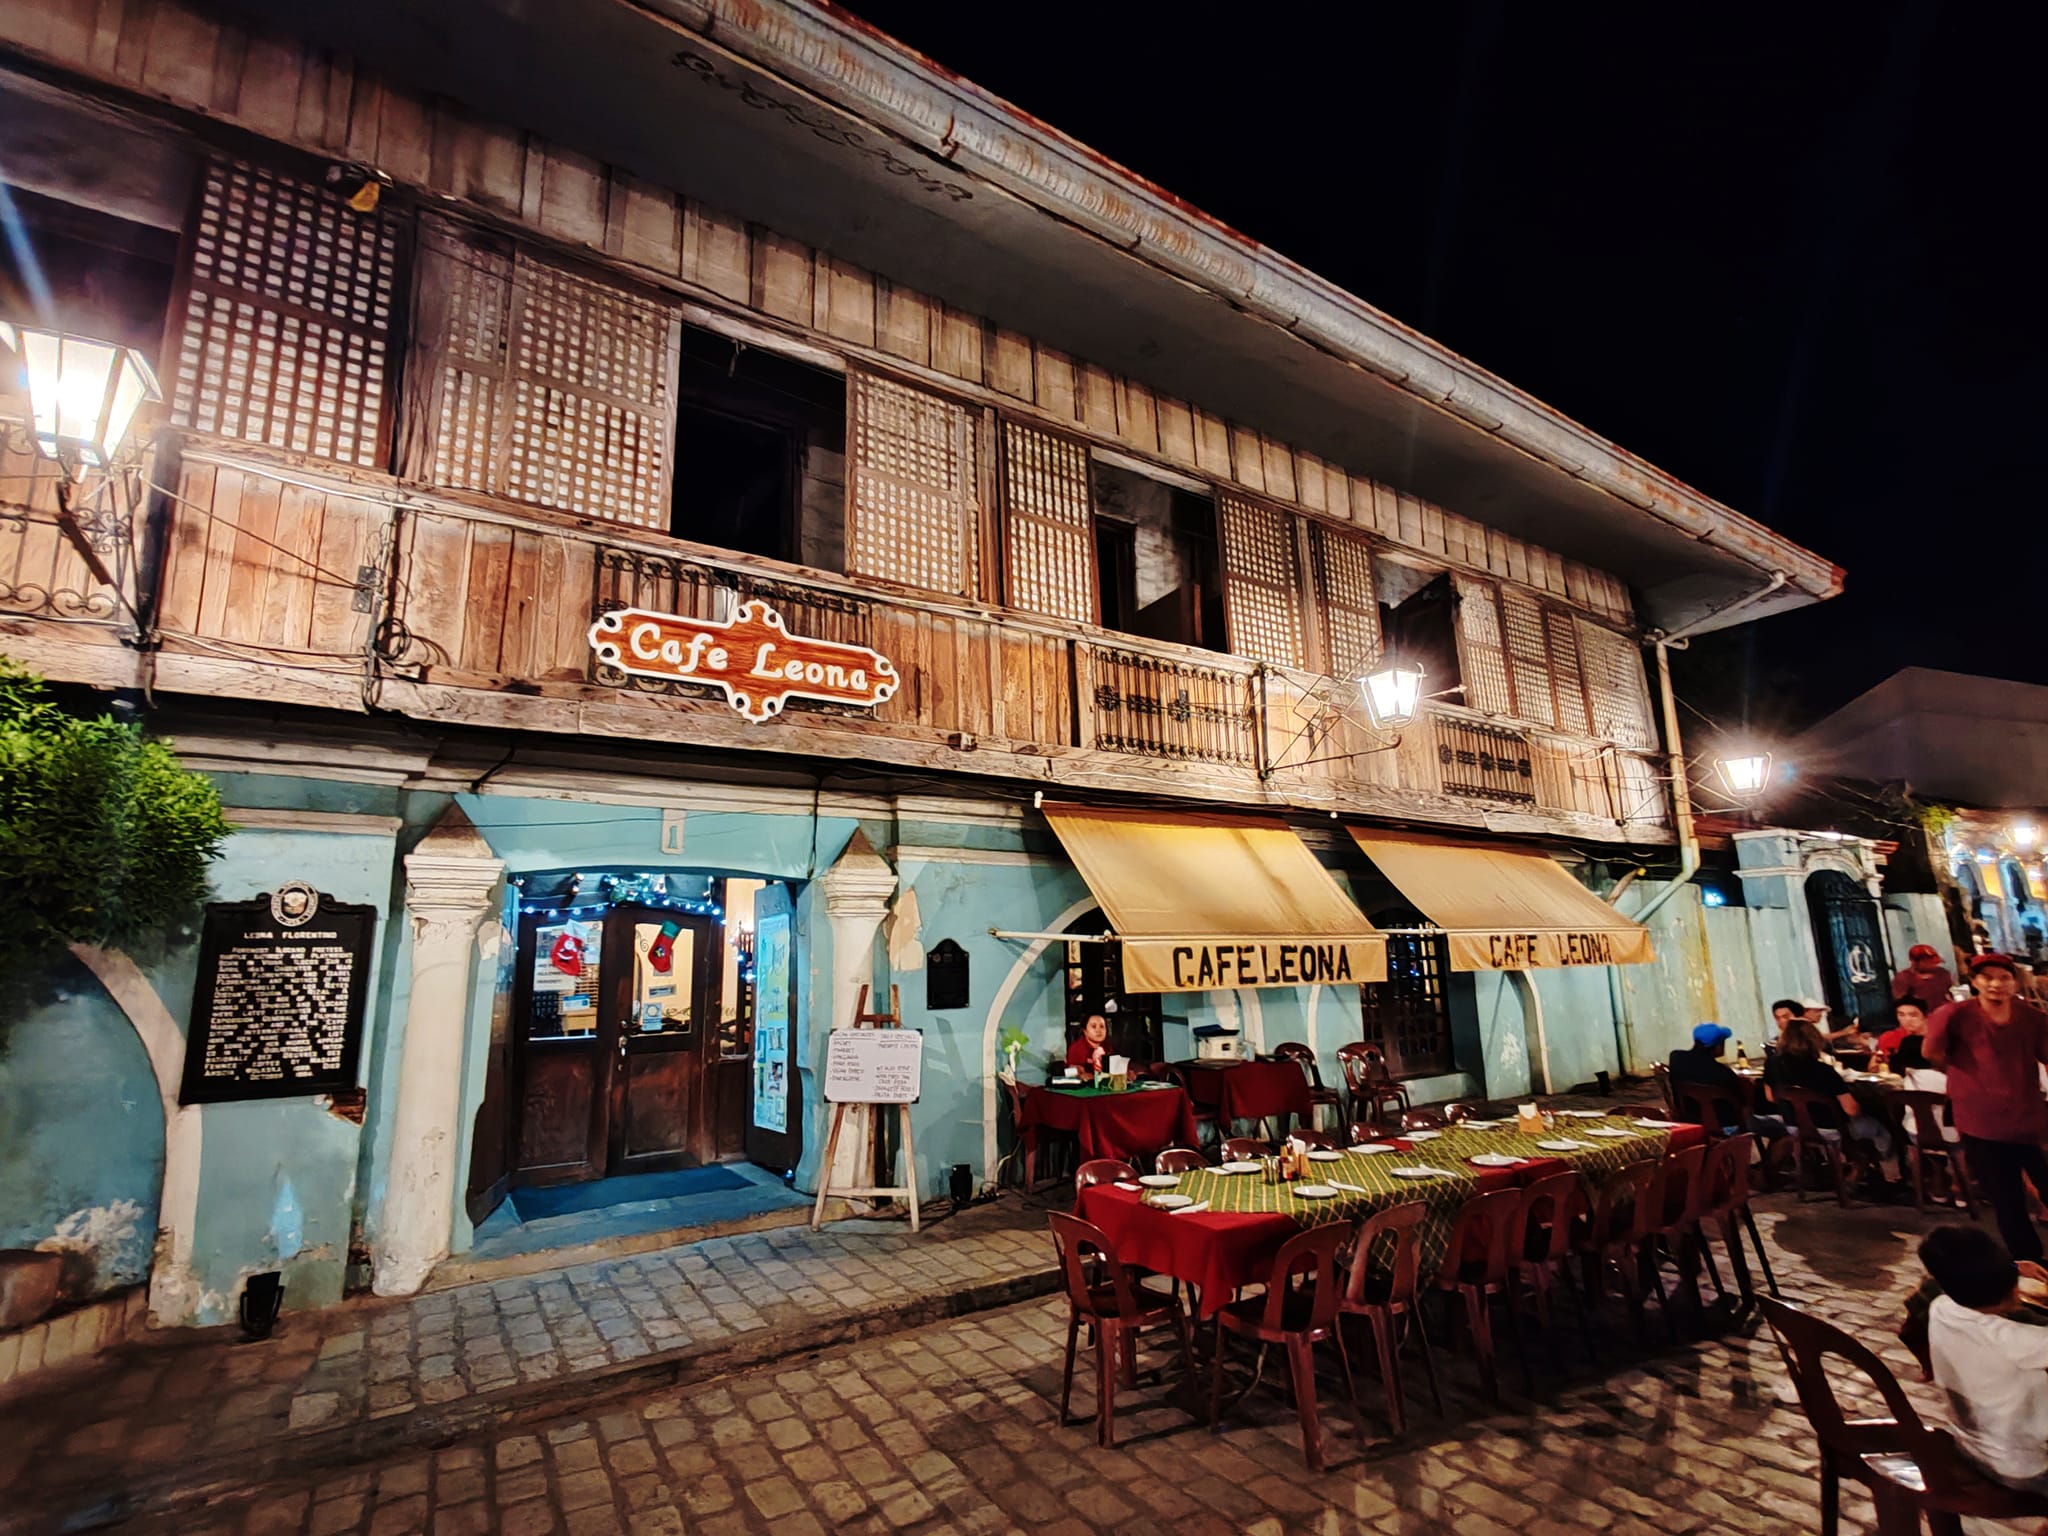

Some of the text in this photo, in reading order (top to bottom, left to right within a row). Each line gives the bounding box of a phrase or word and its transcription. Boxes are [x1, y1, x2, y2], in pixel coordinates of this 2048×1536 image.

[630, 623, 868, 690] Cafe Leona
[1489, 935, 1541, 968] CAFE
